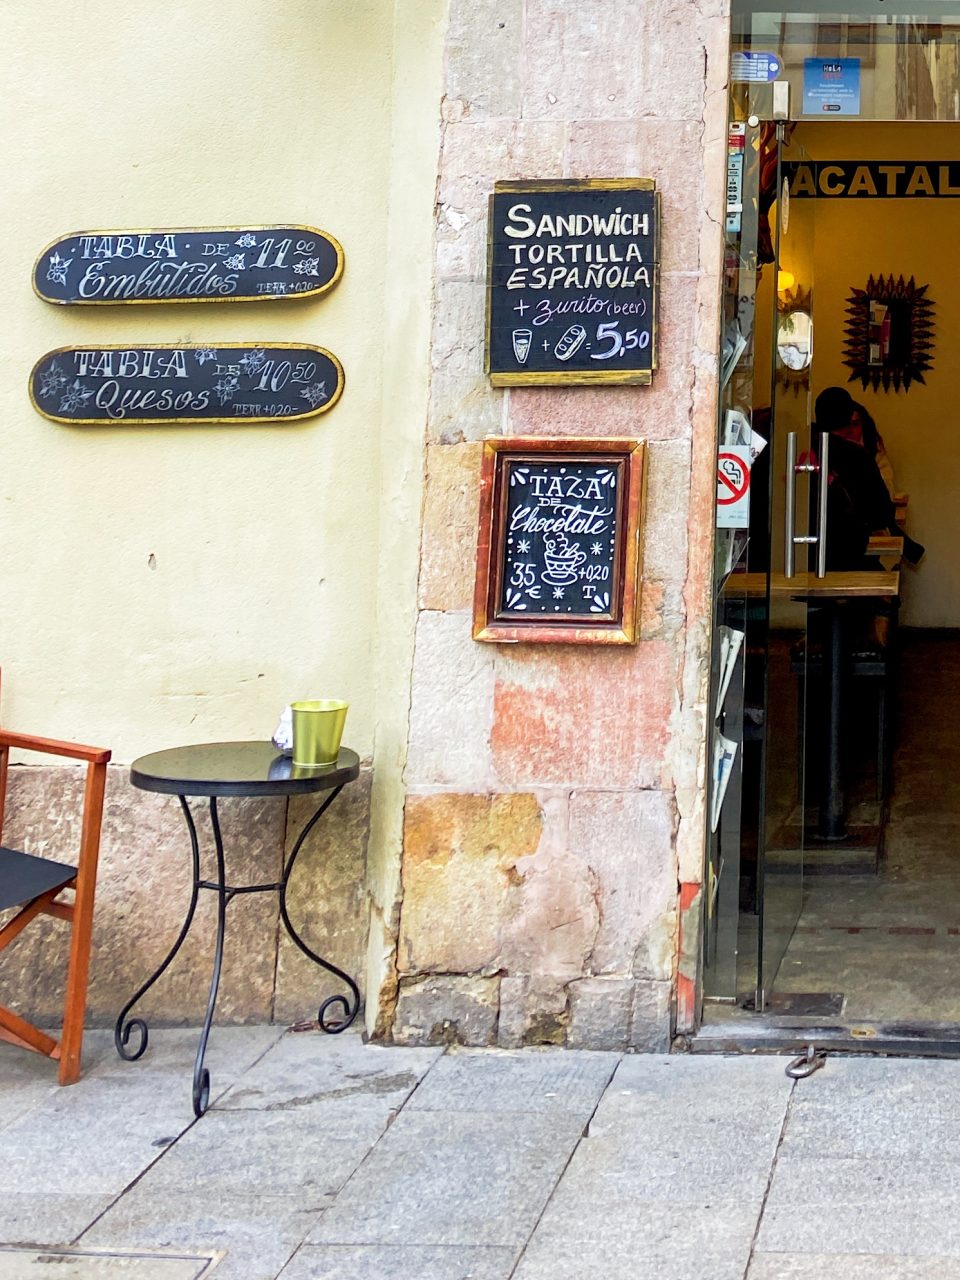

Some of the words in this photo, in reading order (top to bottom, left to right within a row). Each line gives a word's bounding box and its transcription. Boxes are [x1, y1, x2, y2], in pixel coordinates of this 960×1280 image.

[78, 234, 178, 259] TABLA
[201, 241, 231, 257] DE
[508, 243, 643, 265] TORTILLA
[78, 260, 240, 299] Embutidos
[506, 263, 651, 290] ESPAÑOLA
[532, 293, 609, 326] zurito
[607, 298, 647, 317] (beer)
[590, 320, 650, 360] 5,50
[73, 350, 189, 379] TABLA
[211, 363, 241, 376] DE
[95, 380, 211, 419] Quesos
[529, 475, 605, 500] TAZA
[536, 497, 562, 507] DE
[509, 504, 614, 535] Chocolate
[525, 585, 542, 600] €
